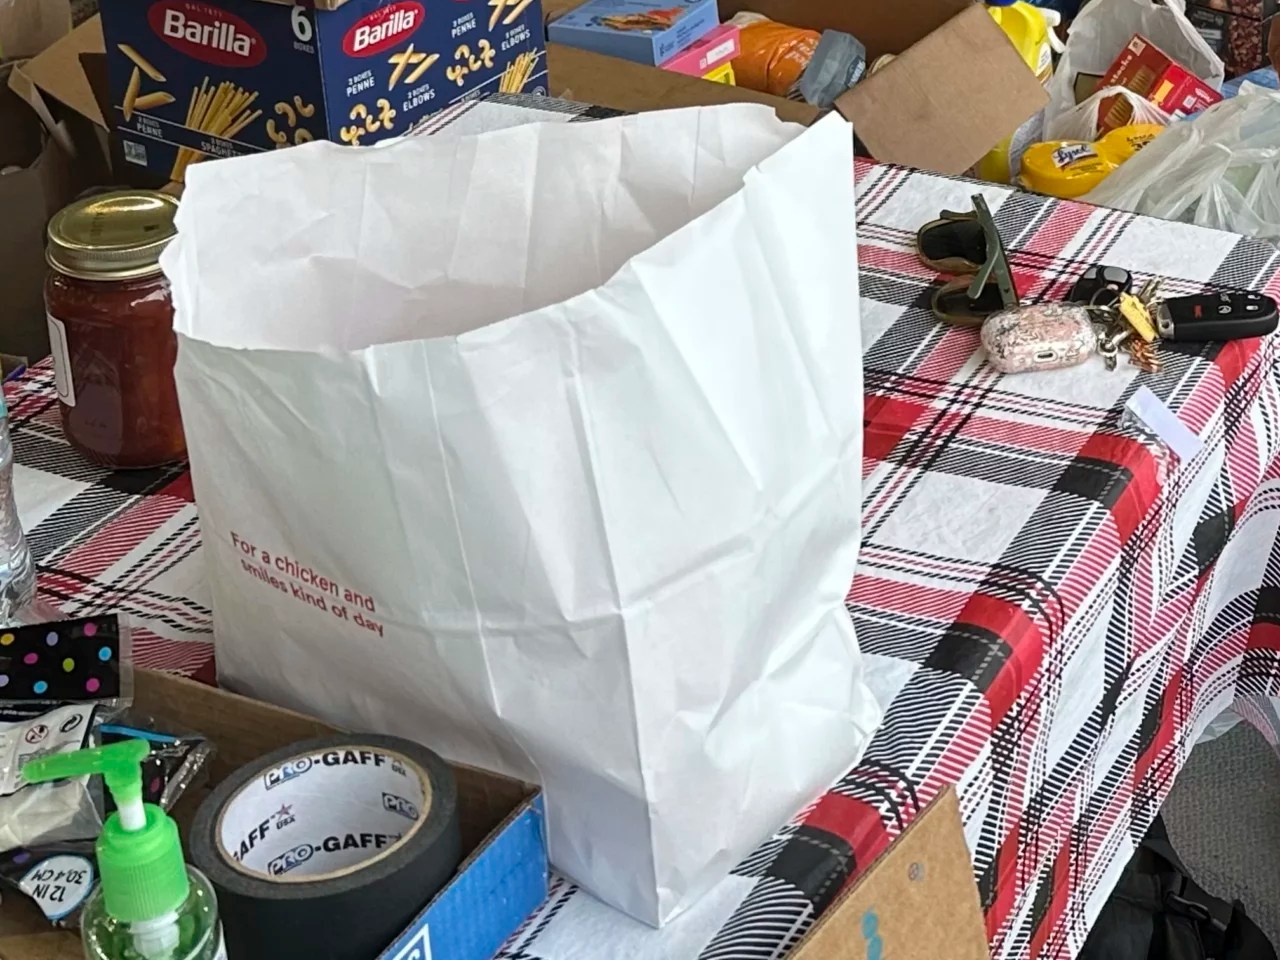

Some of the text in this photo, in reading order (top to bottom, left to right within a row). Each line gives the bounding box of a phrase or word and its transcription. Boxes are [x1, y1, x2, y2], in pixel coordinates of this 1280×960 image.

[163, 8, 252, 57] Barilla
[291, 5, 313, 42] 6
[353, 9, 416, 53] Barilla
[451, 17, 477, 39] PENNE
[501, 28, 531, 51] ELBOWS
[346, 76, 376, 97] PENNE
[402, 88, 436, 112] ELBOWS
[136, 122, 163, 139] PENNE
[1055, 144, 1088, 163] Lysol
[230, 530, 376, 613] For a chicken and
[240, 558, 385, 638] smiles kind of day
[264, 750, 387, 791] PRO-GAFF
[381, 791, 420, 821] PRO
[276, 814, 297, 830] USA
[268, 832, 388, 876] PRO-GAFF
[31, 868, 51, 882] CM
[32, 883, 67, 903] 12 IN
